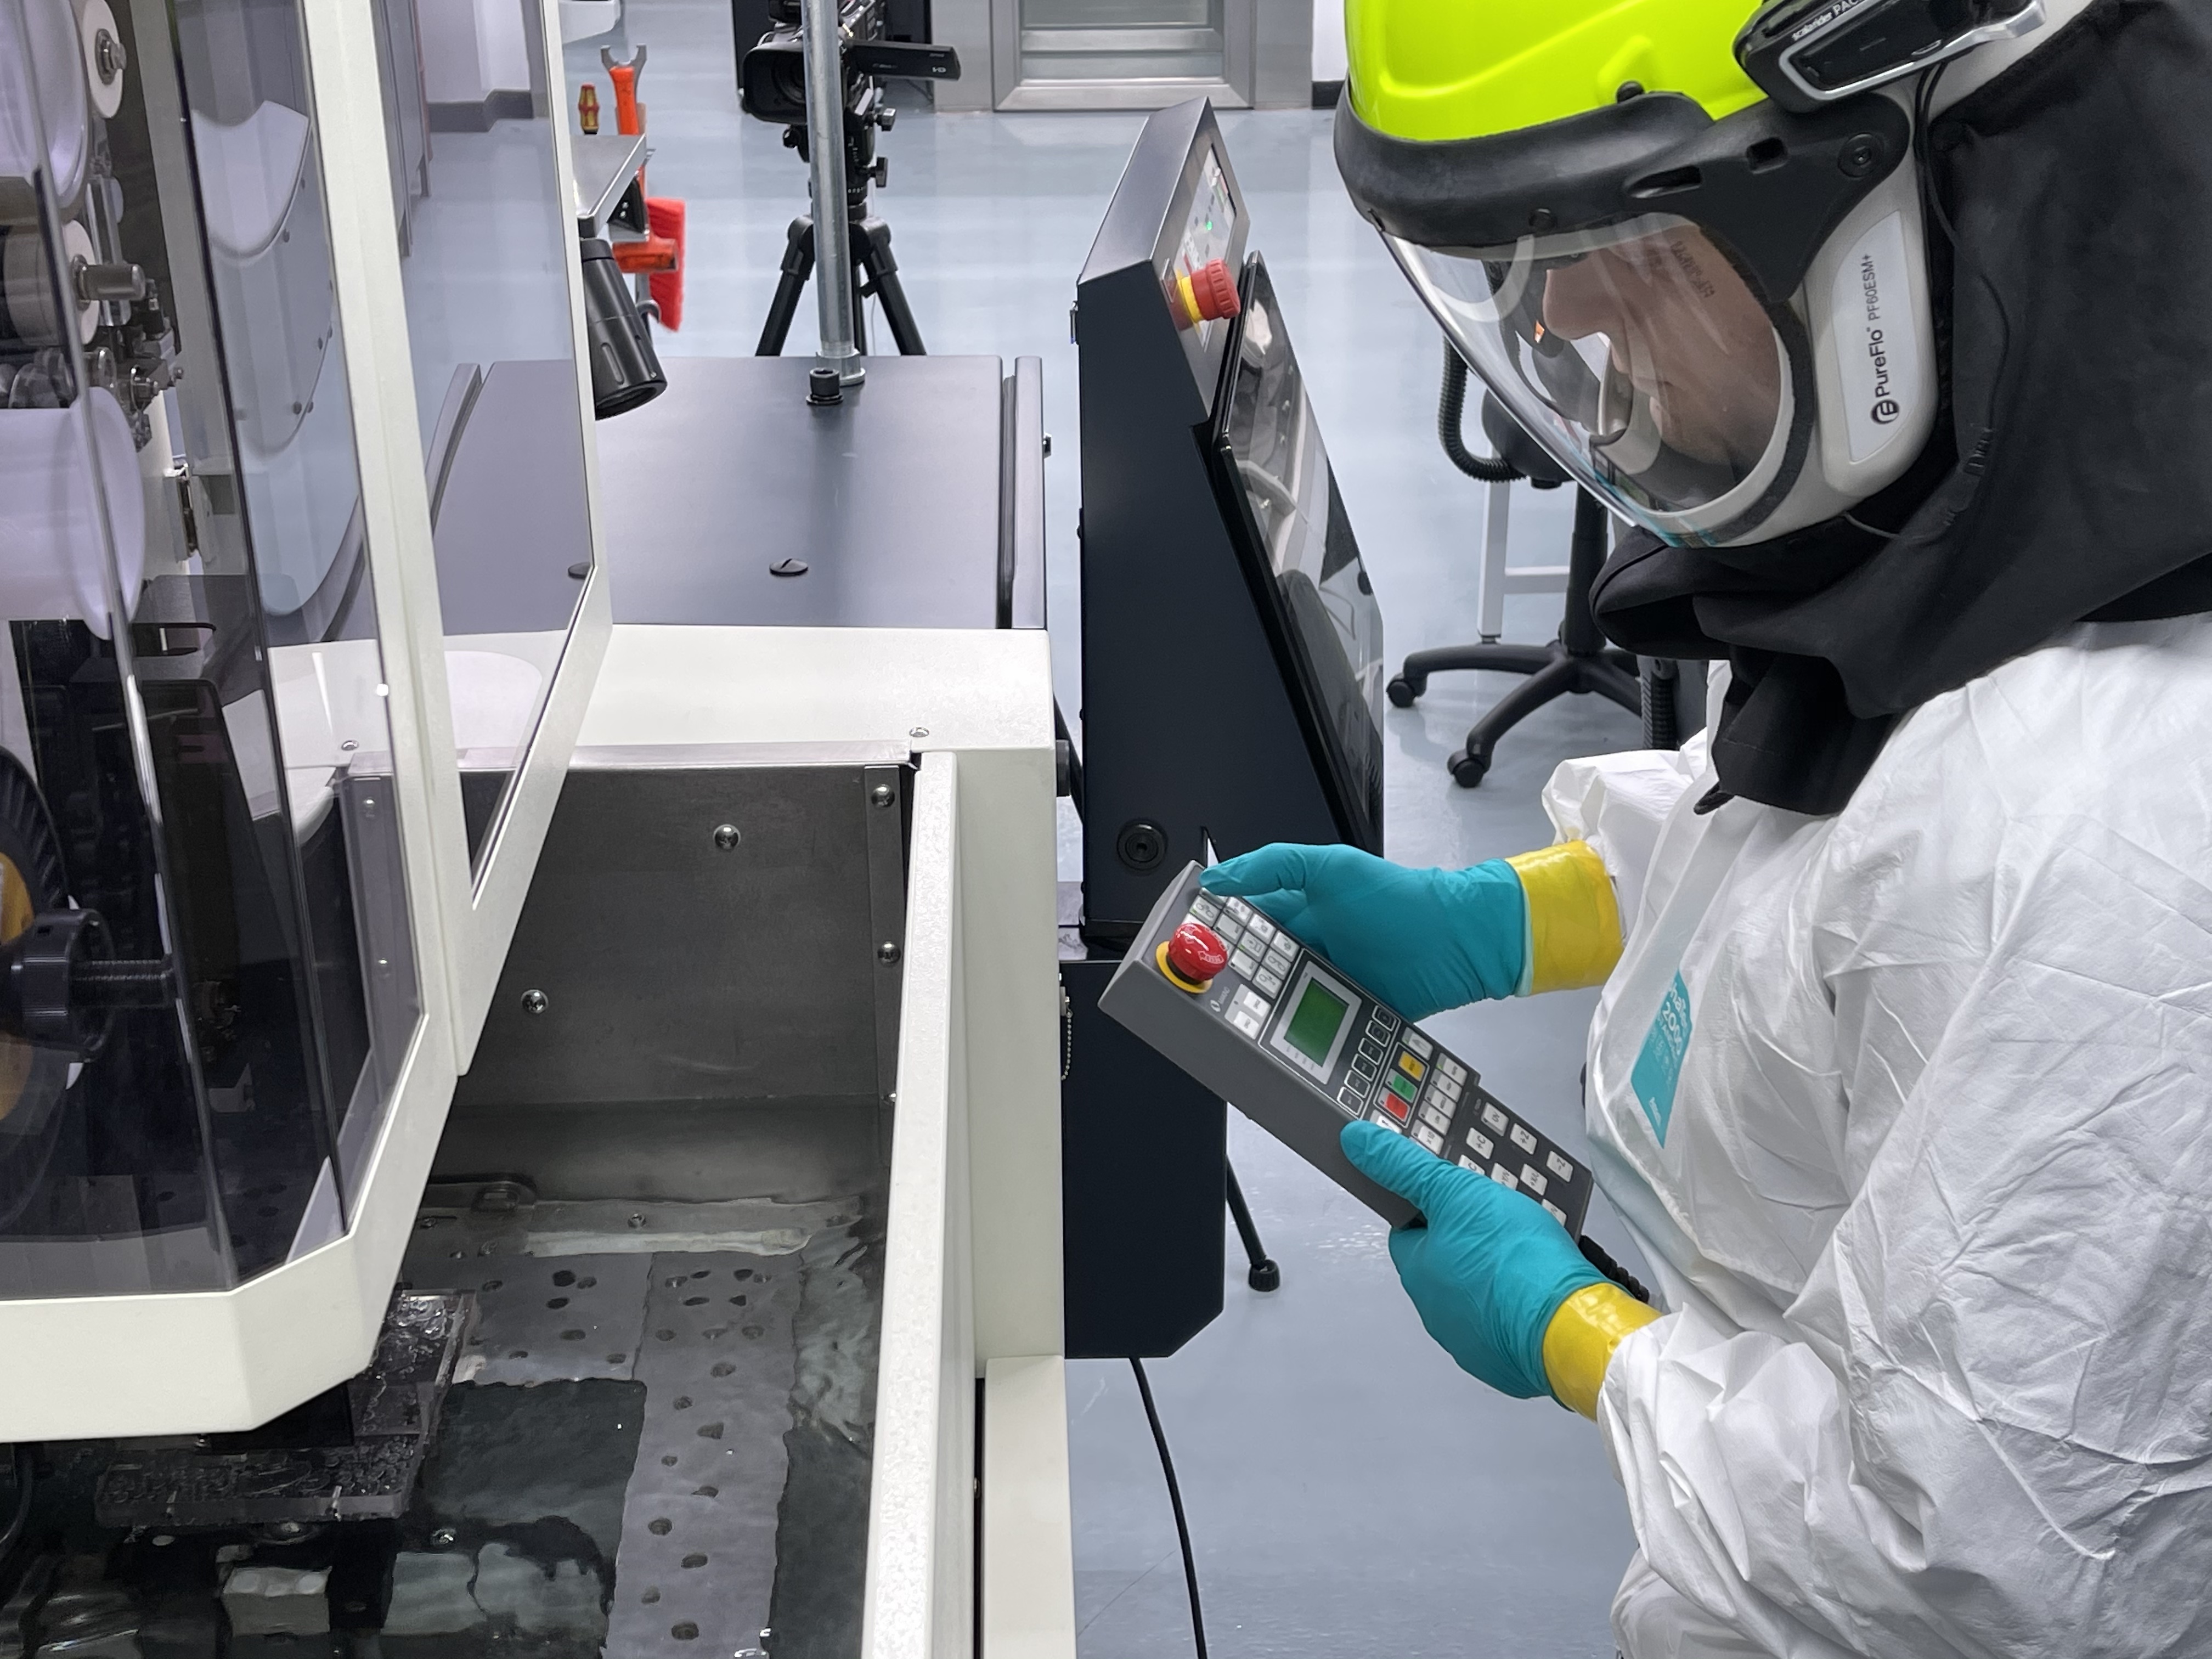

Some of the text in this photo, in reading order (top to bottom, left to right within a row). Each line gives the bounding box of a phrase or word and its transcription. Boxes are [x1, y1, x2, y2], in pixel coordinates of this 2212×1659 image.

[1860, 253, 1890, 398] PureFlo PF60ESM+
[1476, 1134, 1486, 1150] +C
[1520, 1130, 1530, 1144] +Z
